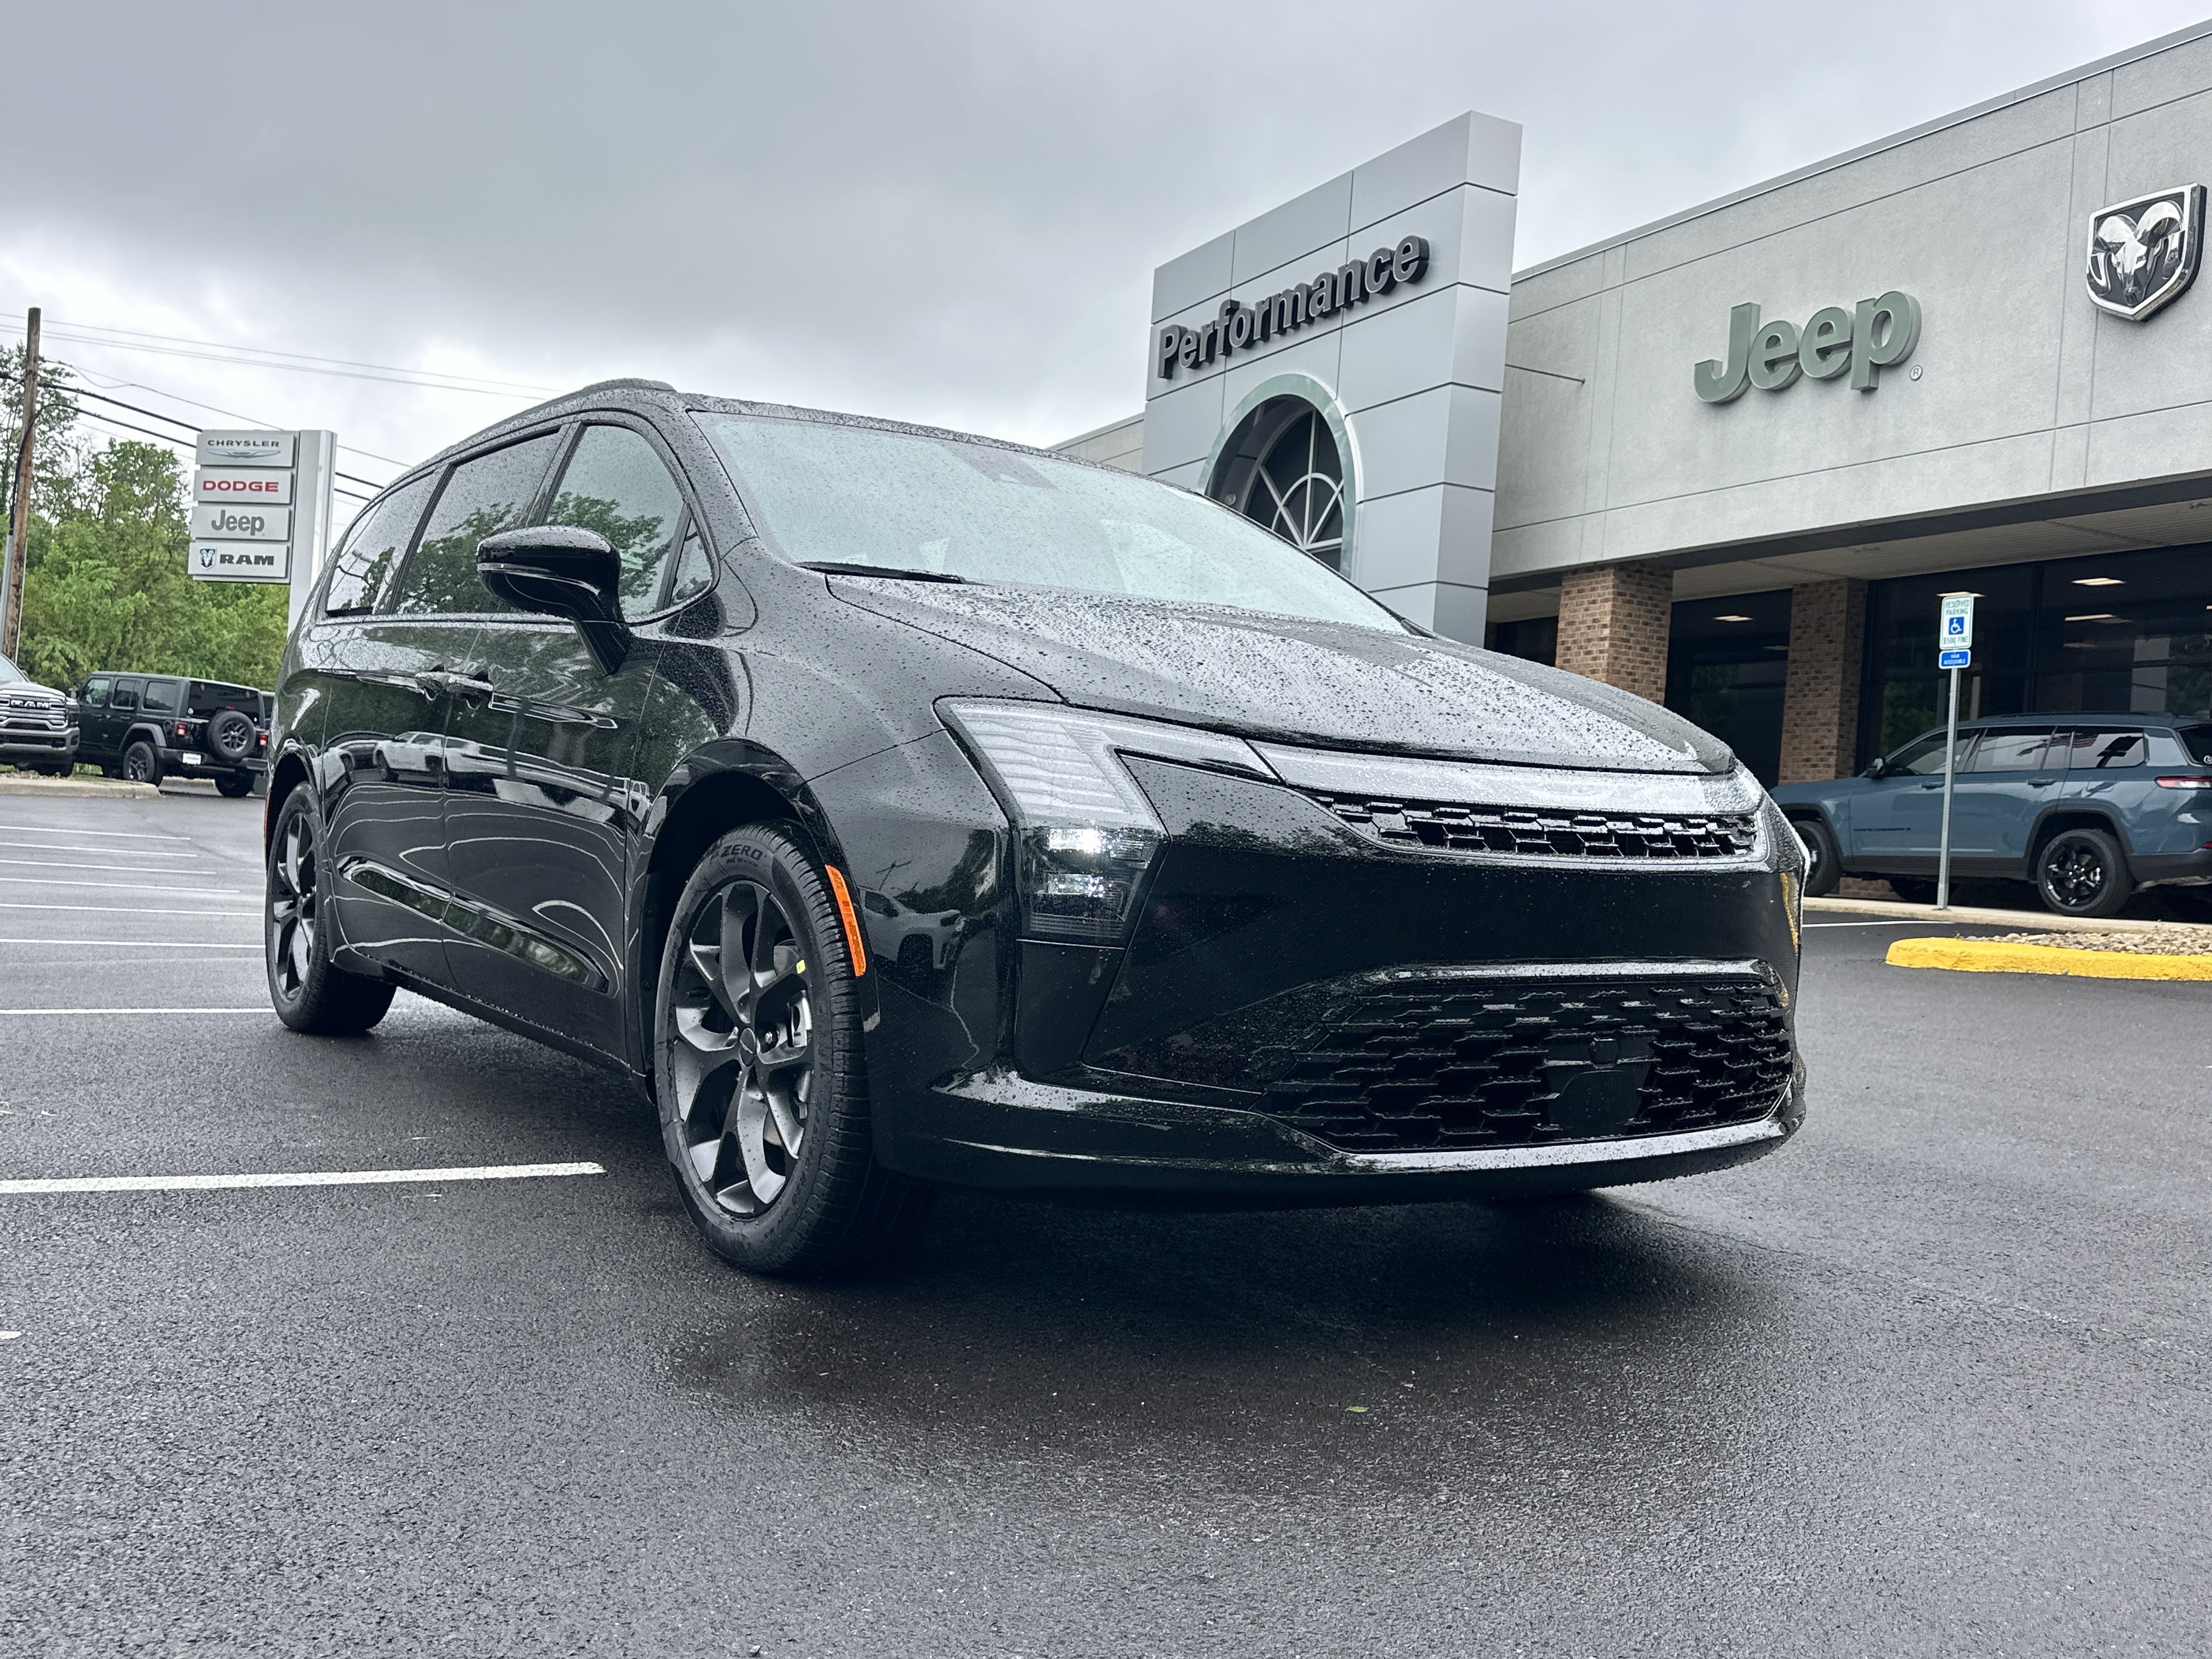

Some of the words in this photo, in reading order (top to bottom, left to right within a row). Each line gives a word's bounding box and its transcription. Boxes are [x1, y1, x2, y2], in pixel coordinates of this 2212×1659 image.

[1158, 235, 1430, 379] Performance
[1694, 291, 1922, 403] Jeep
[202, 481, 279, 492] DODGE
[211, 510, 264, 535] Jeep
[219, 554, 274, 566] RAM
[1946, 607, 1968, 616] PARKING
[720, 844, 763, 860] ZERO
